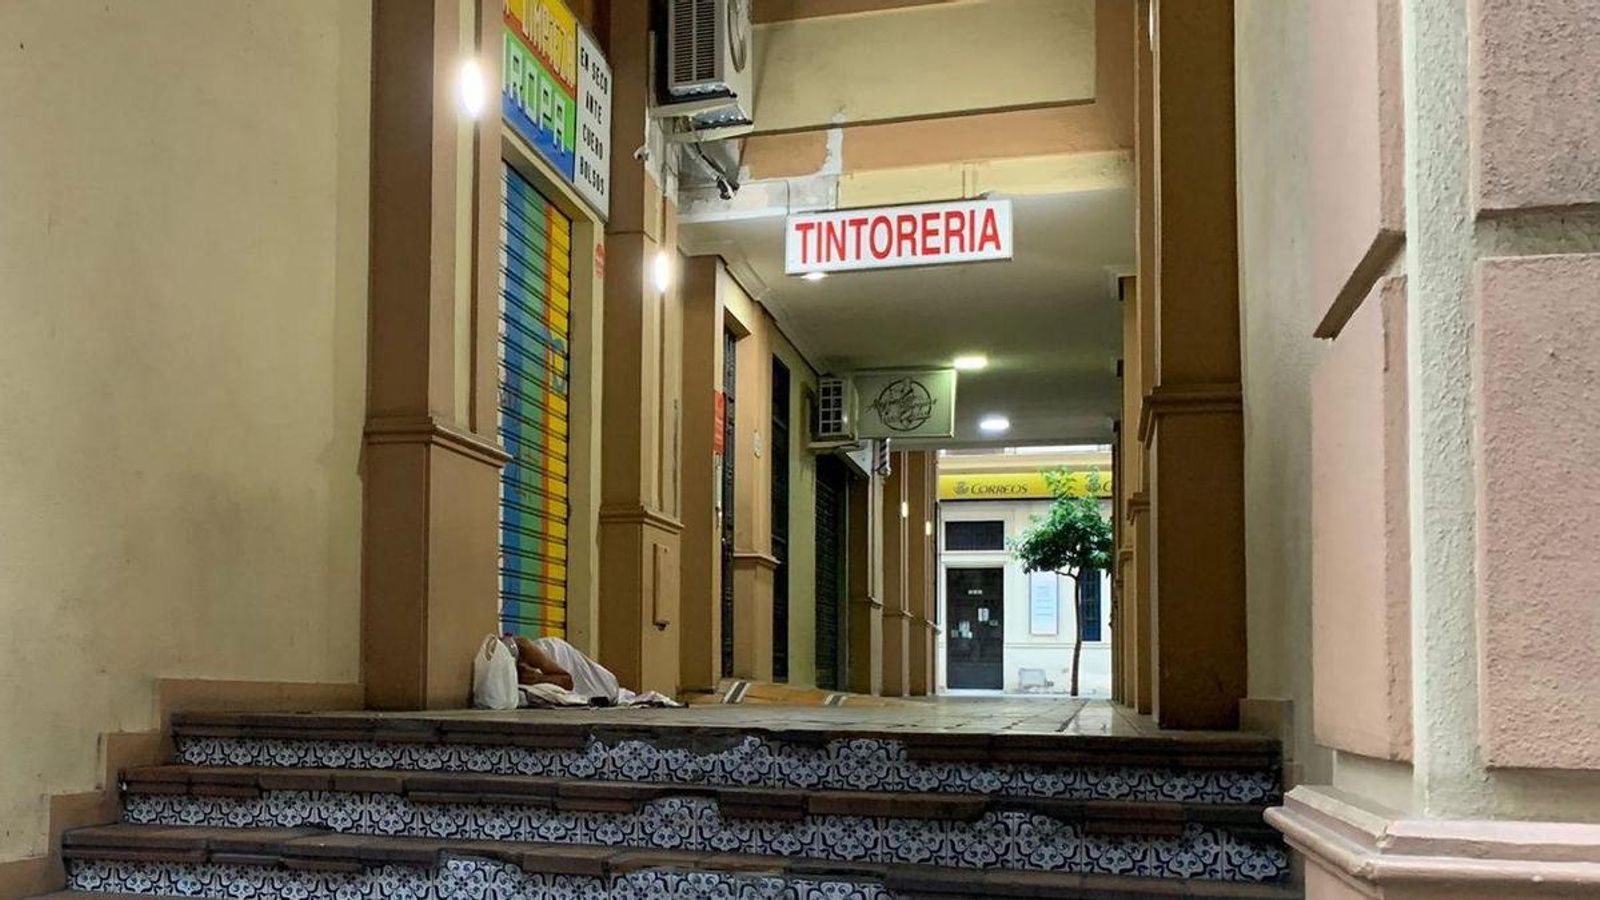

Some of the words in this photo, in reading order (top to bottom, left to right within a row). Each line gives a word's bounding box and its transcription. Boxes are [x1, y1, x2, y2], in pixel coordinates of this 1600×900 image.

[580, 47, 589, 71] EN
[591, 62, 608, 96] SECO
[510, 41, 566, 154] ROPA
[586, 91, 602, 125] ANTE
[582, 124, 603, 161] CUERO
[579, 156, 605, 196] BOLSOS
[794, 208, 1002, 264] TINTORERIA
[970, 482, 1028, 495] CORREOS
